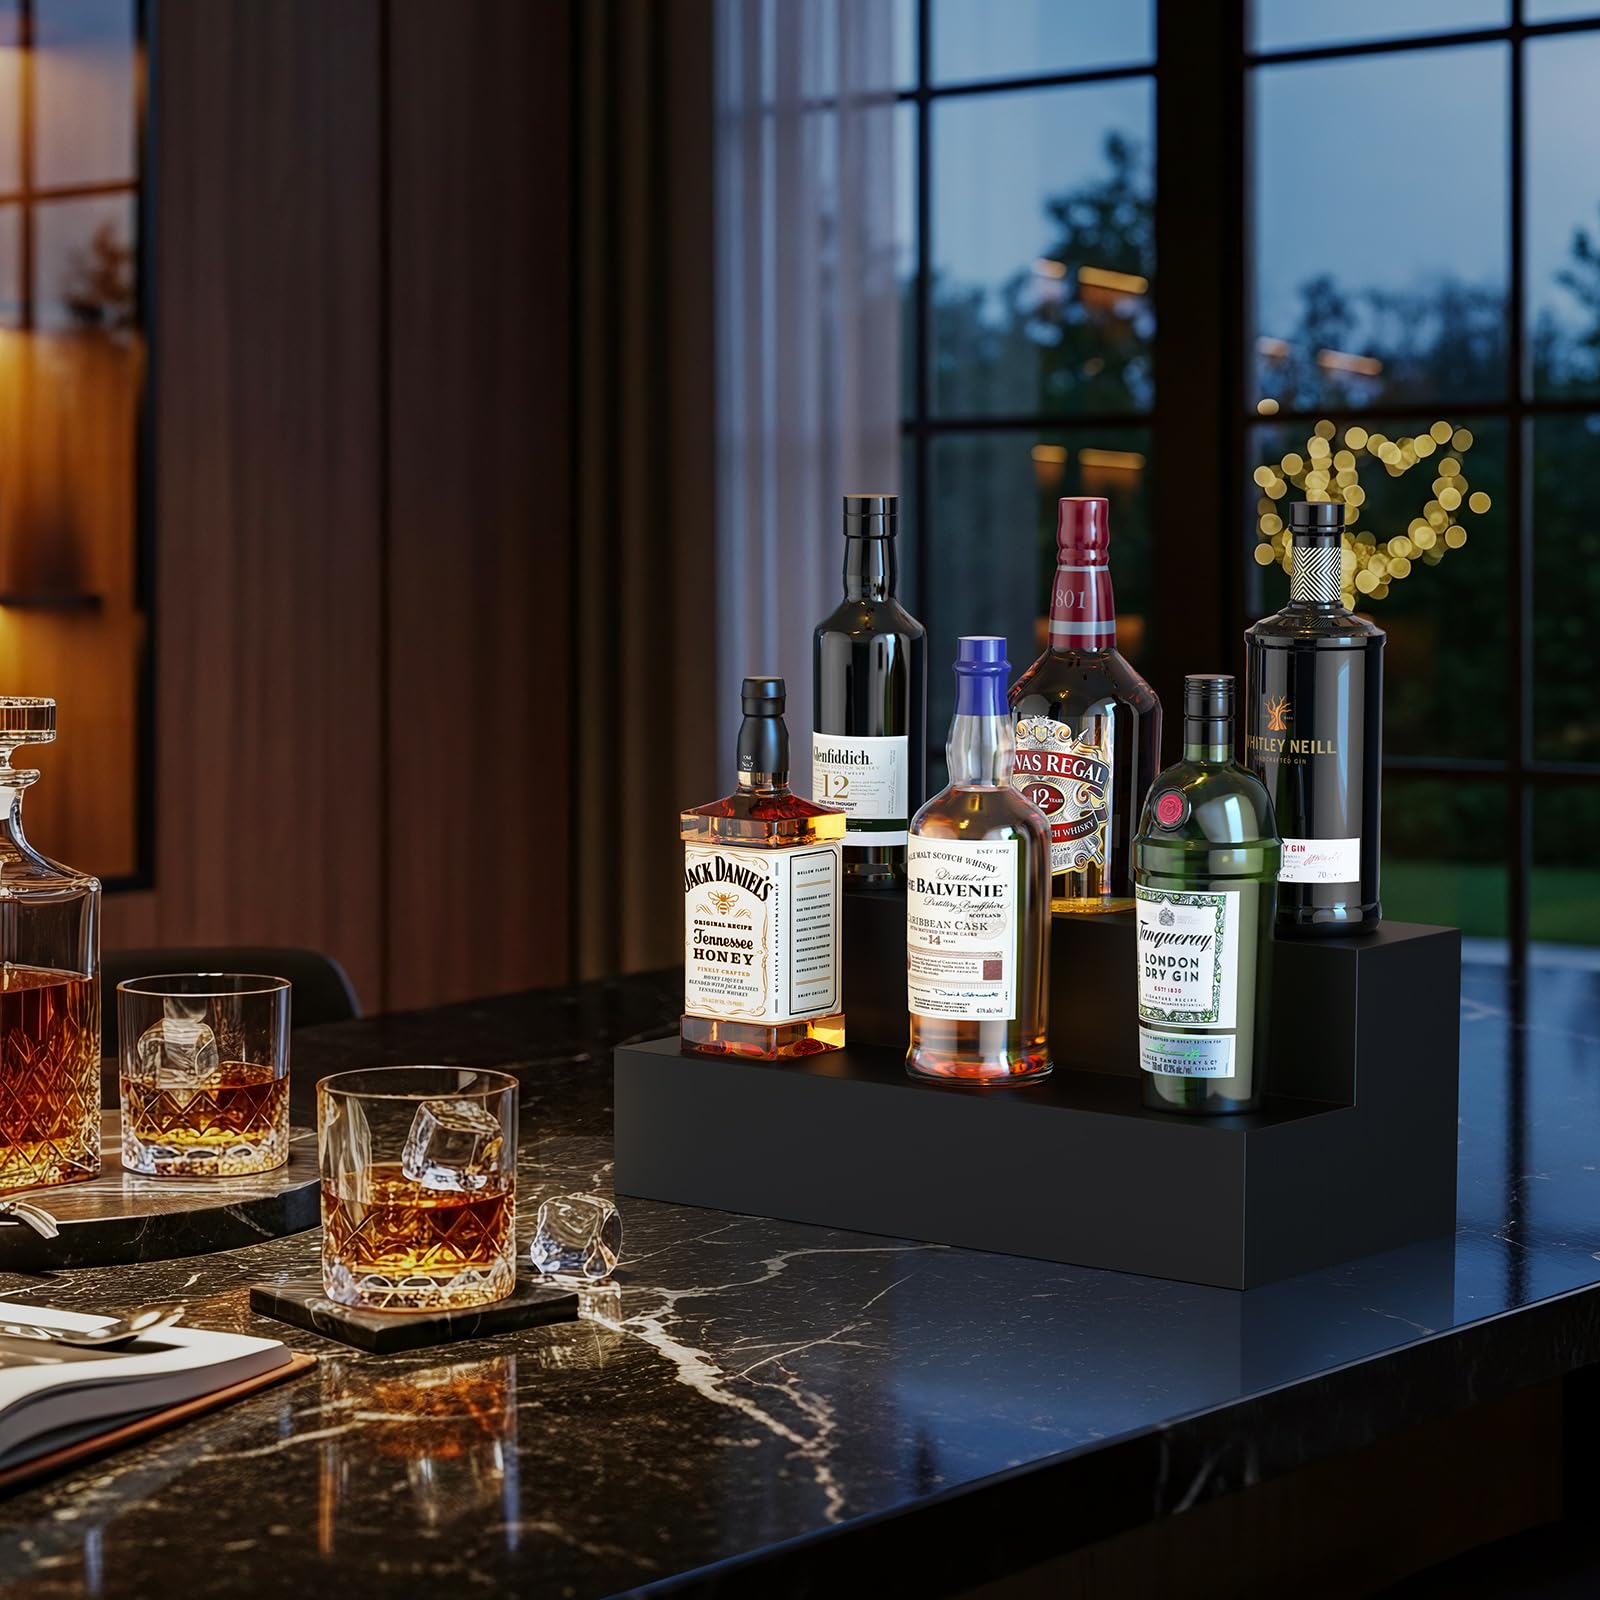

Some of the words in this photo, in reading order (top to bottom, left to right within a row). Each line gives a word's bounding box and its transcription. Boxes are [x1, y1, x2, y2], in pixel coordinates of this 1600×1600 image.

[1248, 736, 1286, 752] HITLEY
[1290, 740, 1336, 754] NEILL
[1014, 754, 1042, 771] VAS
[1046, 754, 1104, 784] REGAL
[823, 774, 850, 798] 12
[1032, 788, 1050, 808] 12
[1062, 821, 1094, 836] WHISKY
[933, 852, 962, 863] SCOTCH
[965, 858, 998, 872] WHISKY
[685, 862, 714, 893] JACK
[715, 856, 774, 902] DANIEL'S
[917, 878, 1003, 897] BALVENIE
[694, 920, 726, 928] ORIGINAL
[955, 921, 988, 931] CASK
[693, 928, 754, 950] Tennessee
[928, 935, 940, 945] 14
[1140, 920, 1212, 952] Tanqueray
[693, 948, 754, 965] HONEY
[1145, 953, 1199, 968] LONDON
[697, 966, 720, 974] FINELY
[1146, 967, 1166, 980] DRY
[1172, 971, 1199, 981] GIN
[1160, 1057, 1202, 1065] TANQUERAY
